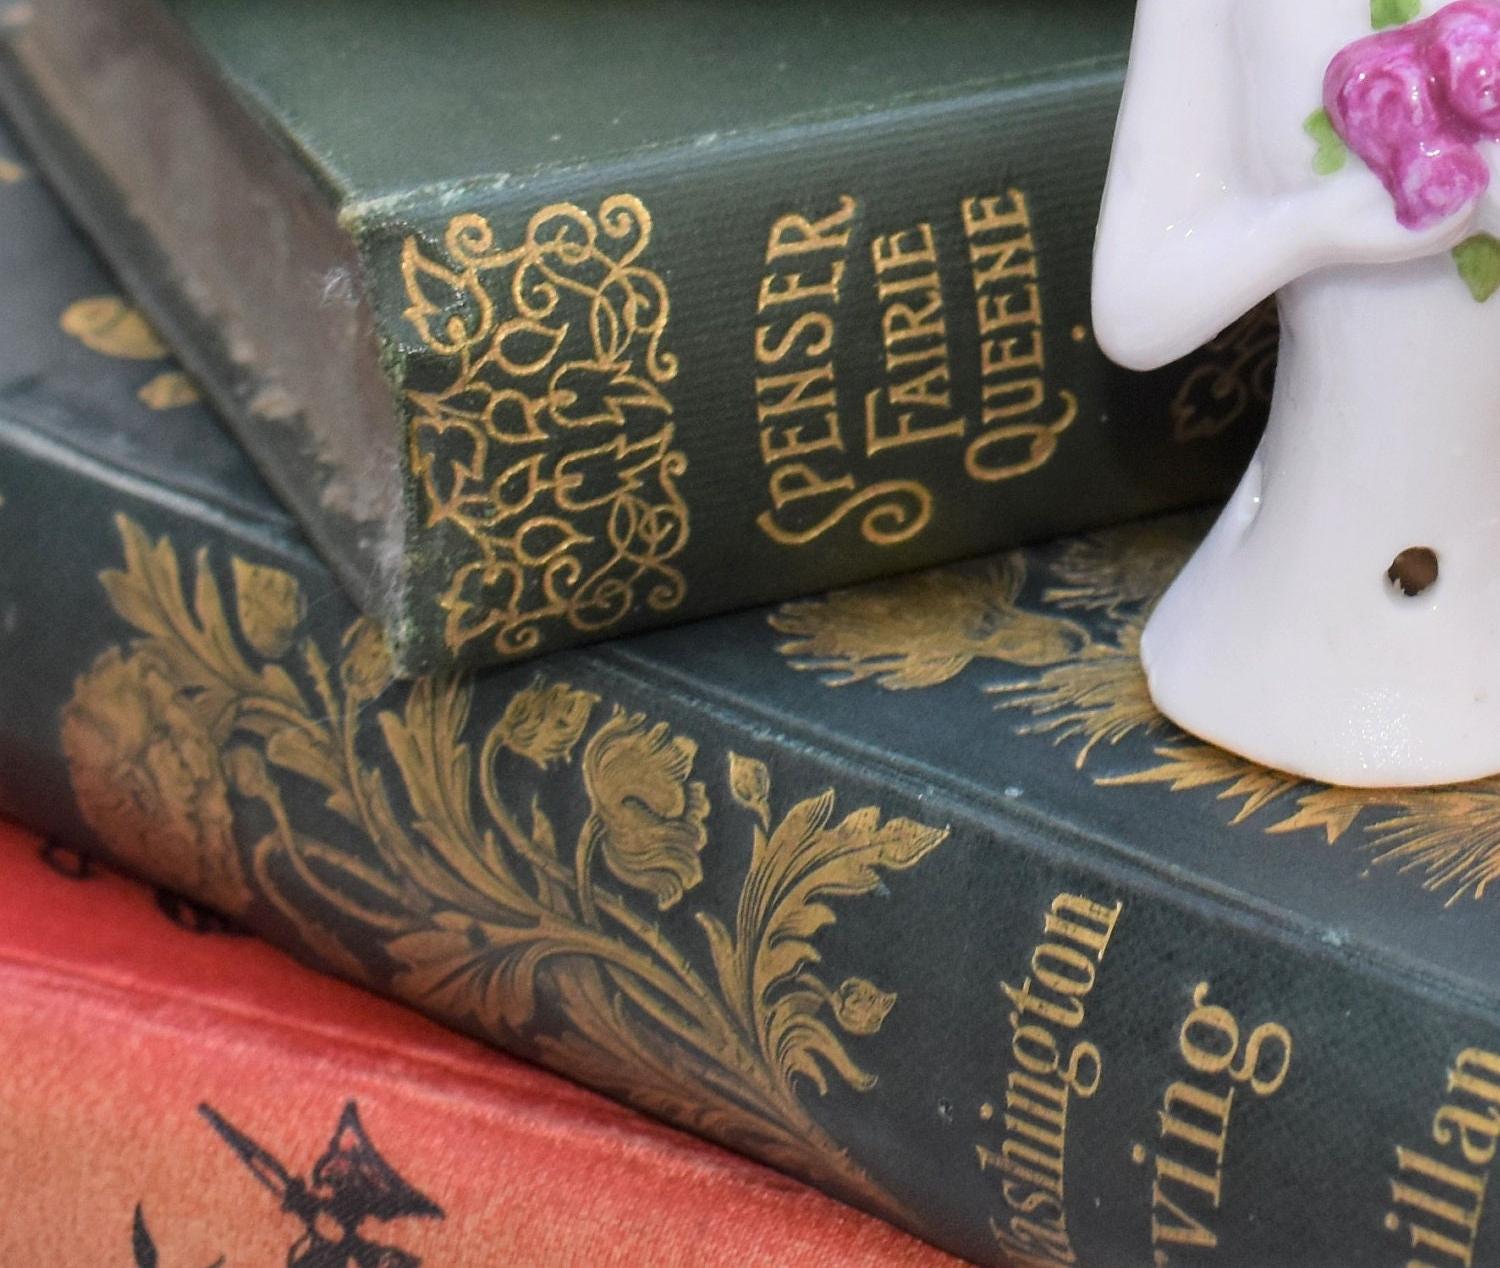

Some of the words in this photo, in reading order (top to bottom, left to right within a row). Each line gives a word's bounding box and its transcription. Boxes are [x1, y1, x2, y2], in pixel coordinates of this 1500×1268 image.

[755, 194, 932, 546] SPENSER
[865, 223, 967, 458] FAIRIE
[961, 187, 1078, 481] QUEENE
